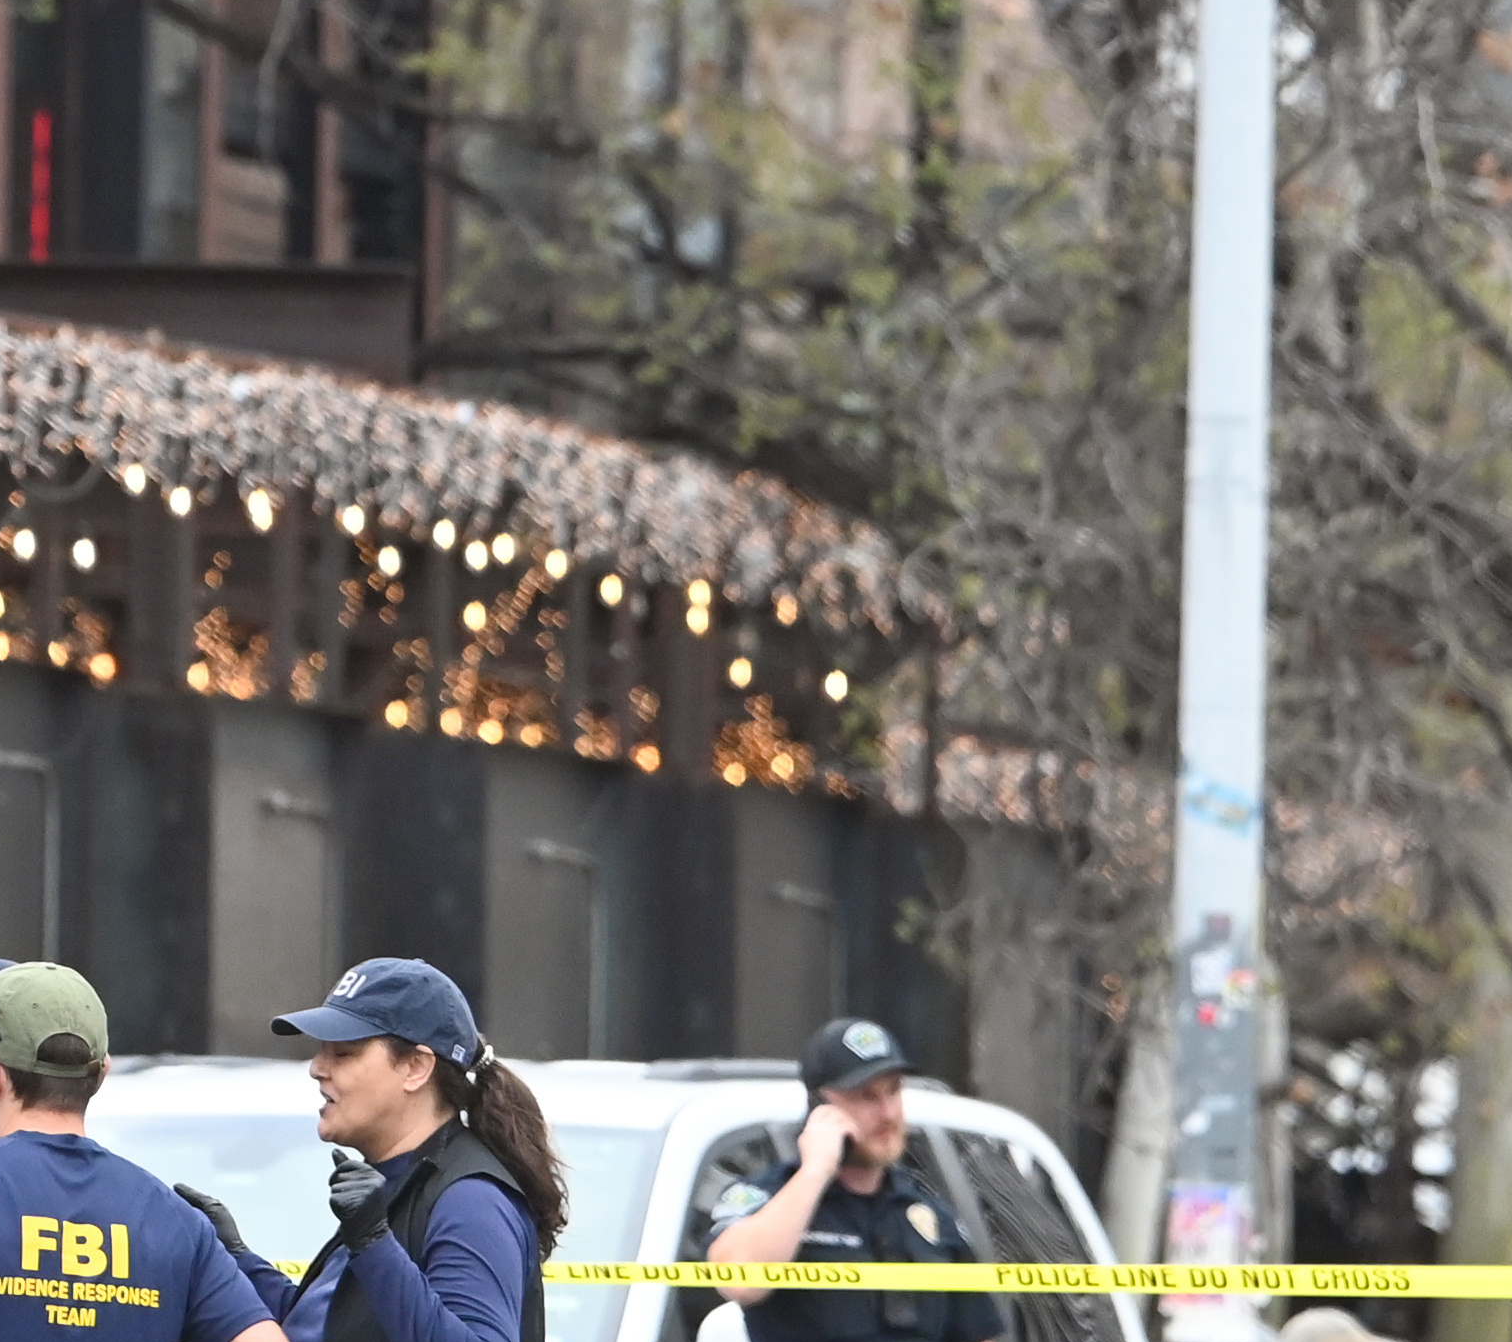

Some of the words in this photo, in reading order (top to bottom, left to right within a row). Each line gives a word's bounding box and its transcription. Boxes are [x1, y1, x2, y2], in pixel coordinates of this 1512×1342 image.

[333, 971, 367, 999] BI
[21, 1215, 130, 1279] FBI
[996, 1266, 1101, 1287] POLICE
[1113, 1267, 1177, 1288] LINE
[1189, 1267, 1227, 1289] DO
[1242, 1267, 1296, 1290] NOT
[1311, 1268, 1411, 1291] CROSS
[73, 1282, 161, 1308] RESPONSE
[45, 1303, 97, 1327] TEAM
